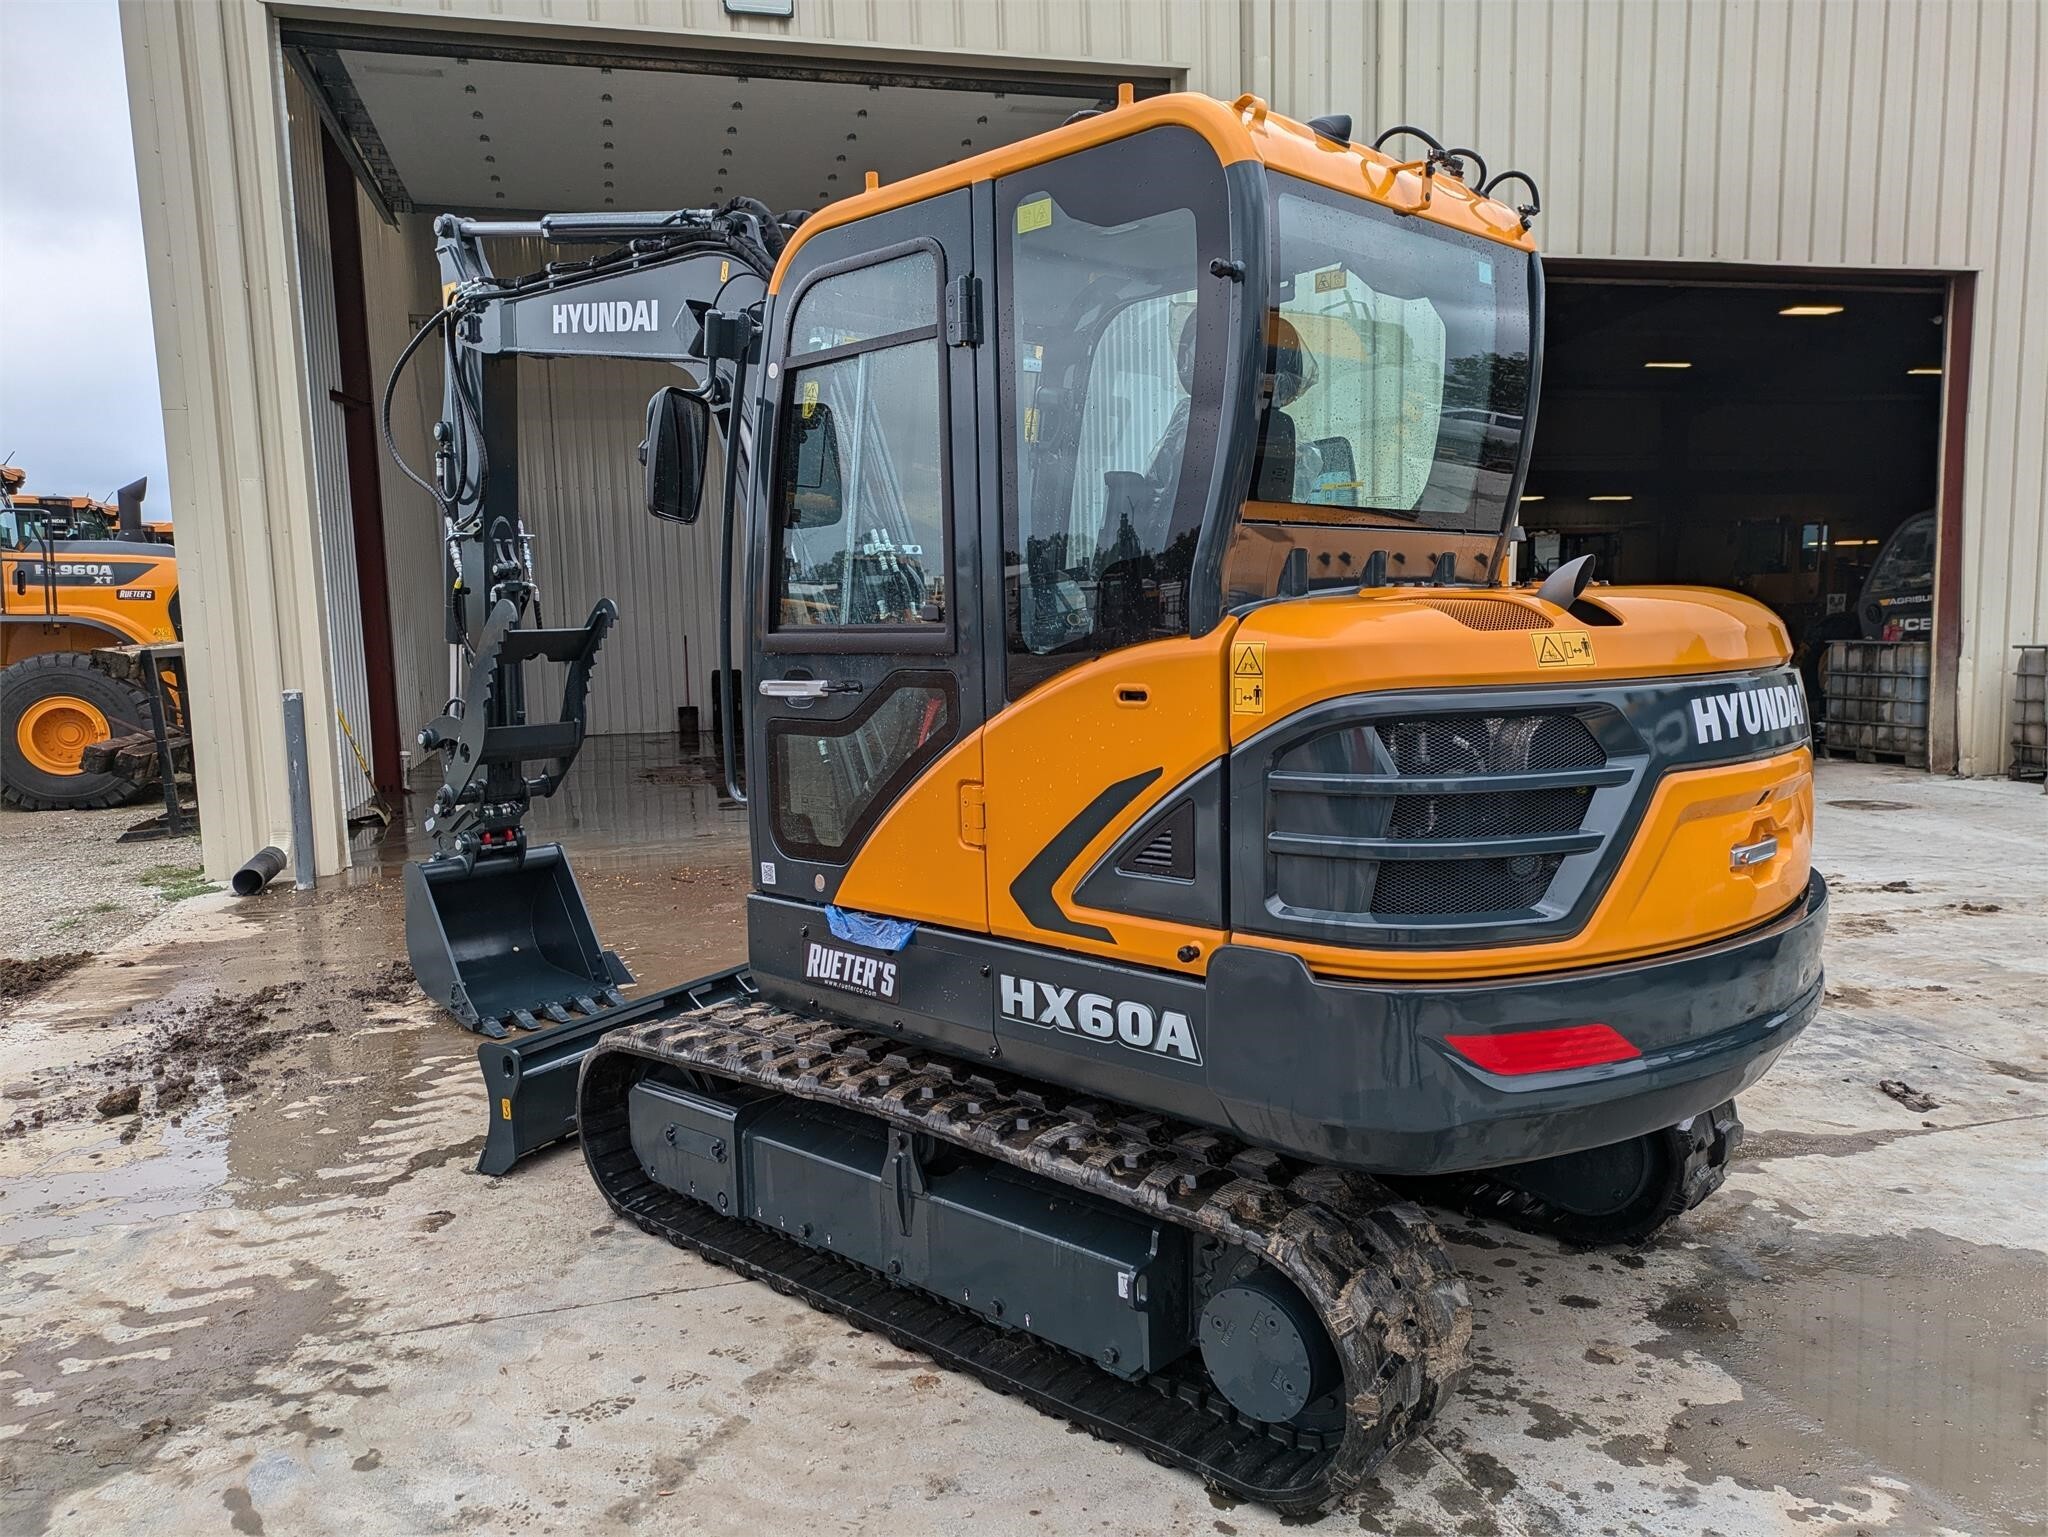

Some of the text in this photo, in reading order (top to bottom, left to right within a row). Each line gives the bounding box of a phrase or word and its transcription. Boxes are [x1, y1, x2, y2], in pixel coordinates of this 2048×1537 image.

[552, 299, 659, 334] HYUNDAI
[94, 576, 113, 584] XT
[119, 589, 153, 599] RUETER'S
[1889, 594, 1933, 606] AGRISU
[1690, 684, 1805, 745] HYUNDAI
[806, 943, 897, 997] RUETER'S
[824, 979, 878, 997] www.rueterco.com
[1000, 973, 1198, 1060] HX60A
